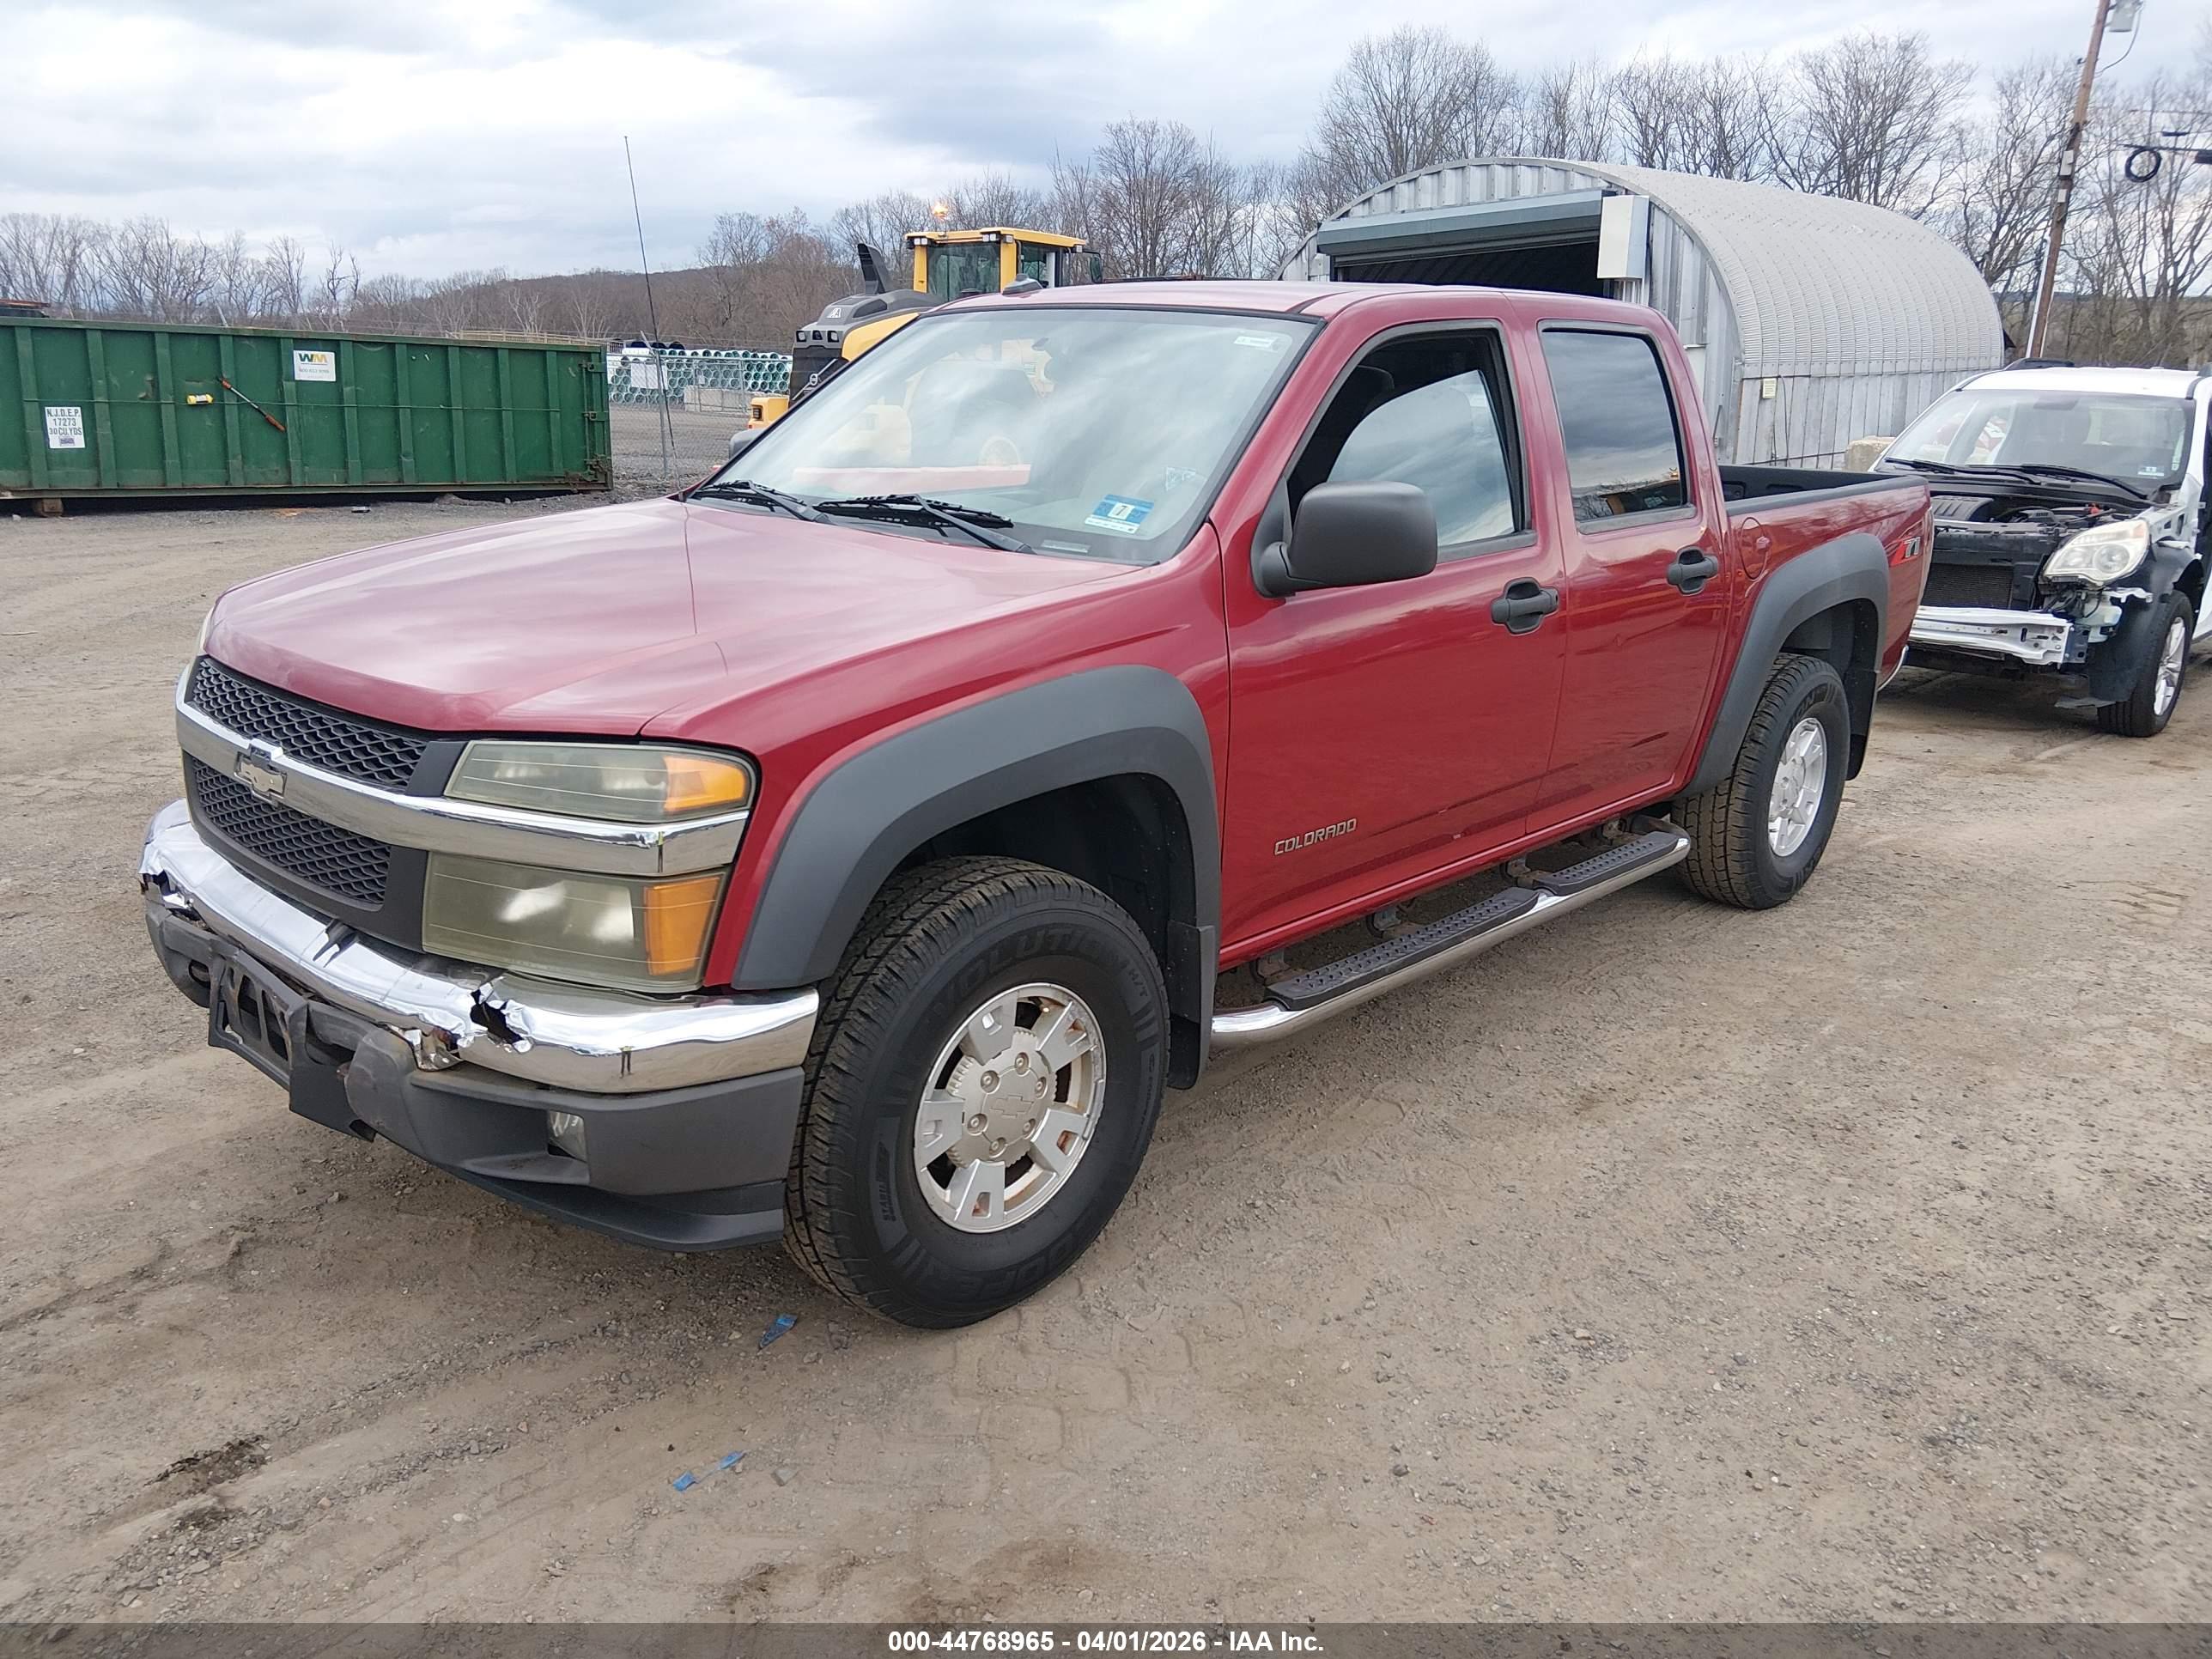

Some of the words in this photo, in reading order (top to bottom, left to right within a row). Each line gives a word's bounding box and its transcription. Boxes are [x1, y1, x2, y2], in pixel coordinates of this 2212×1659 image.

[298, 353, 328, 362] WM
[53, 417, 76, 427] 17273
[1273, 818, 1358, 856] COLORADO
